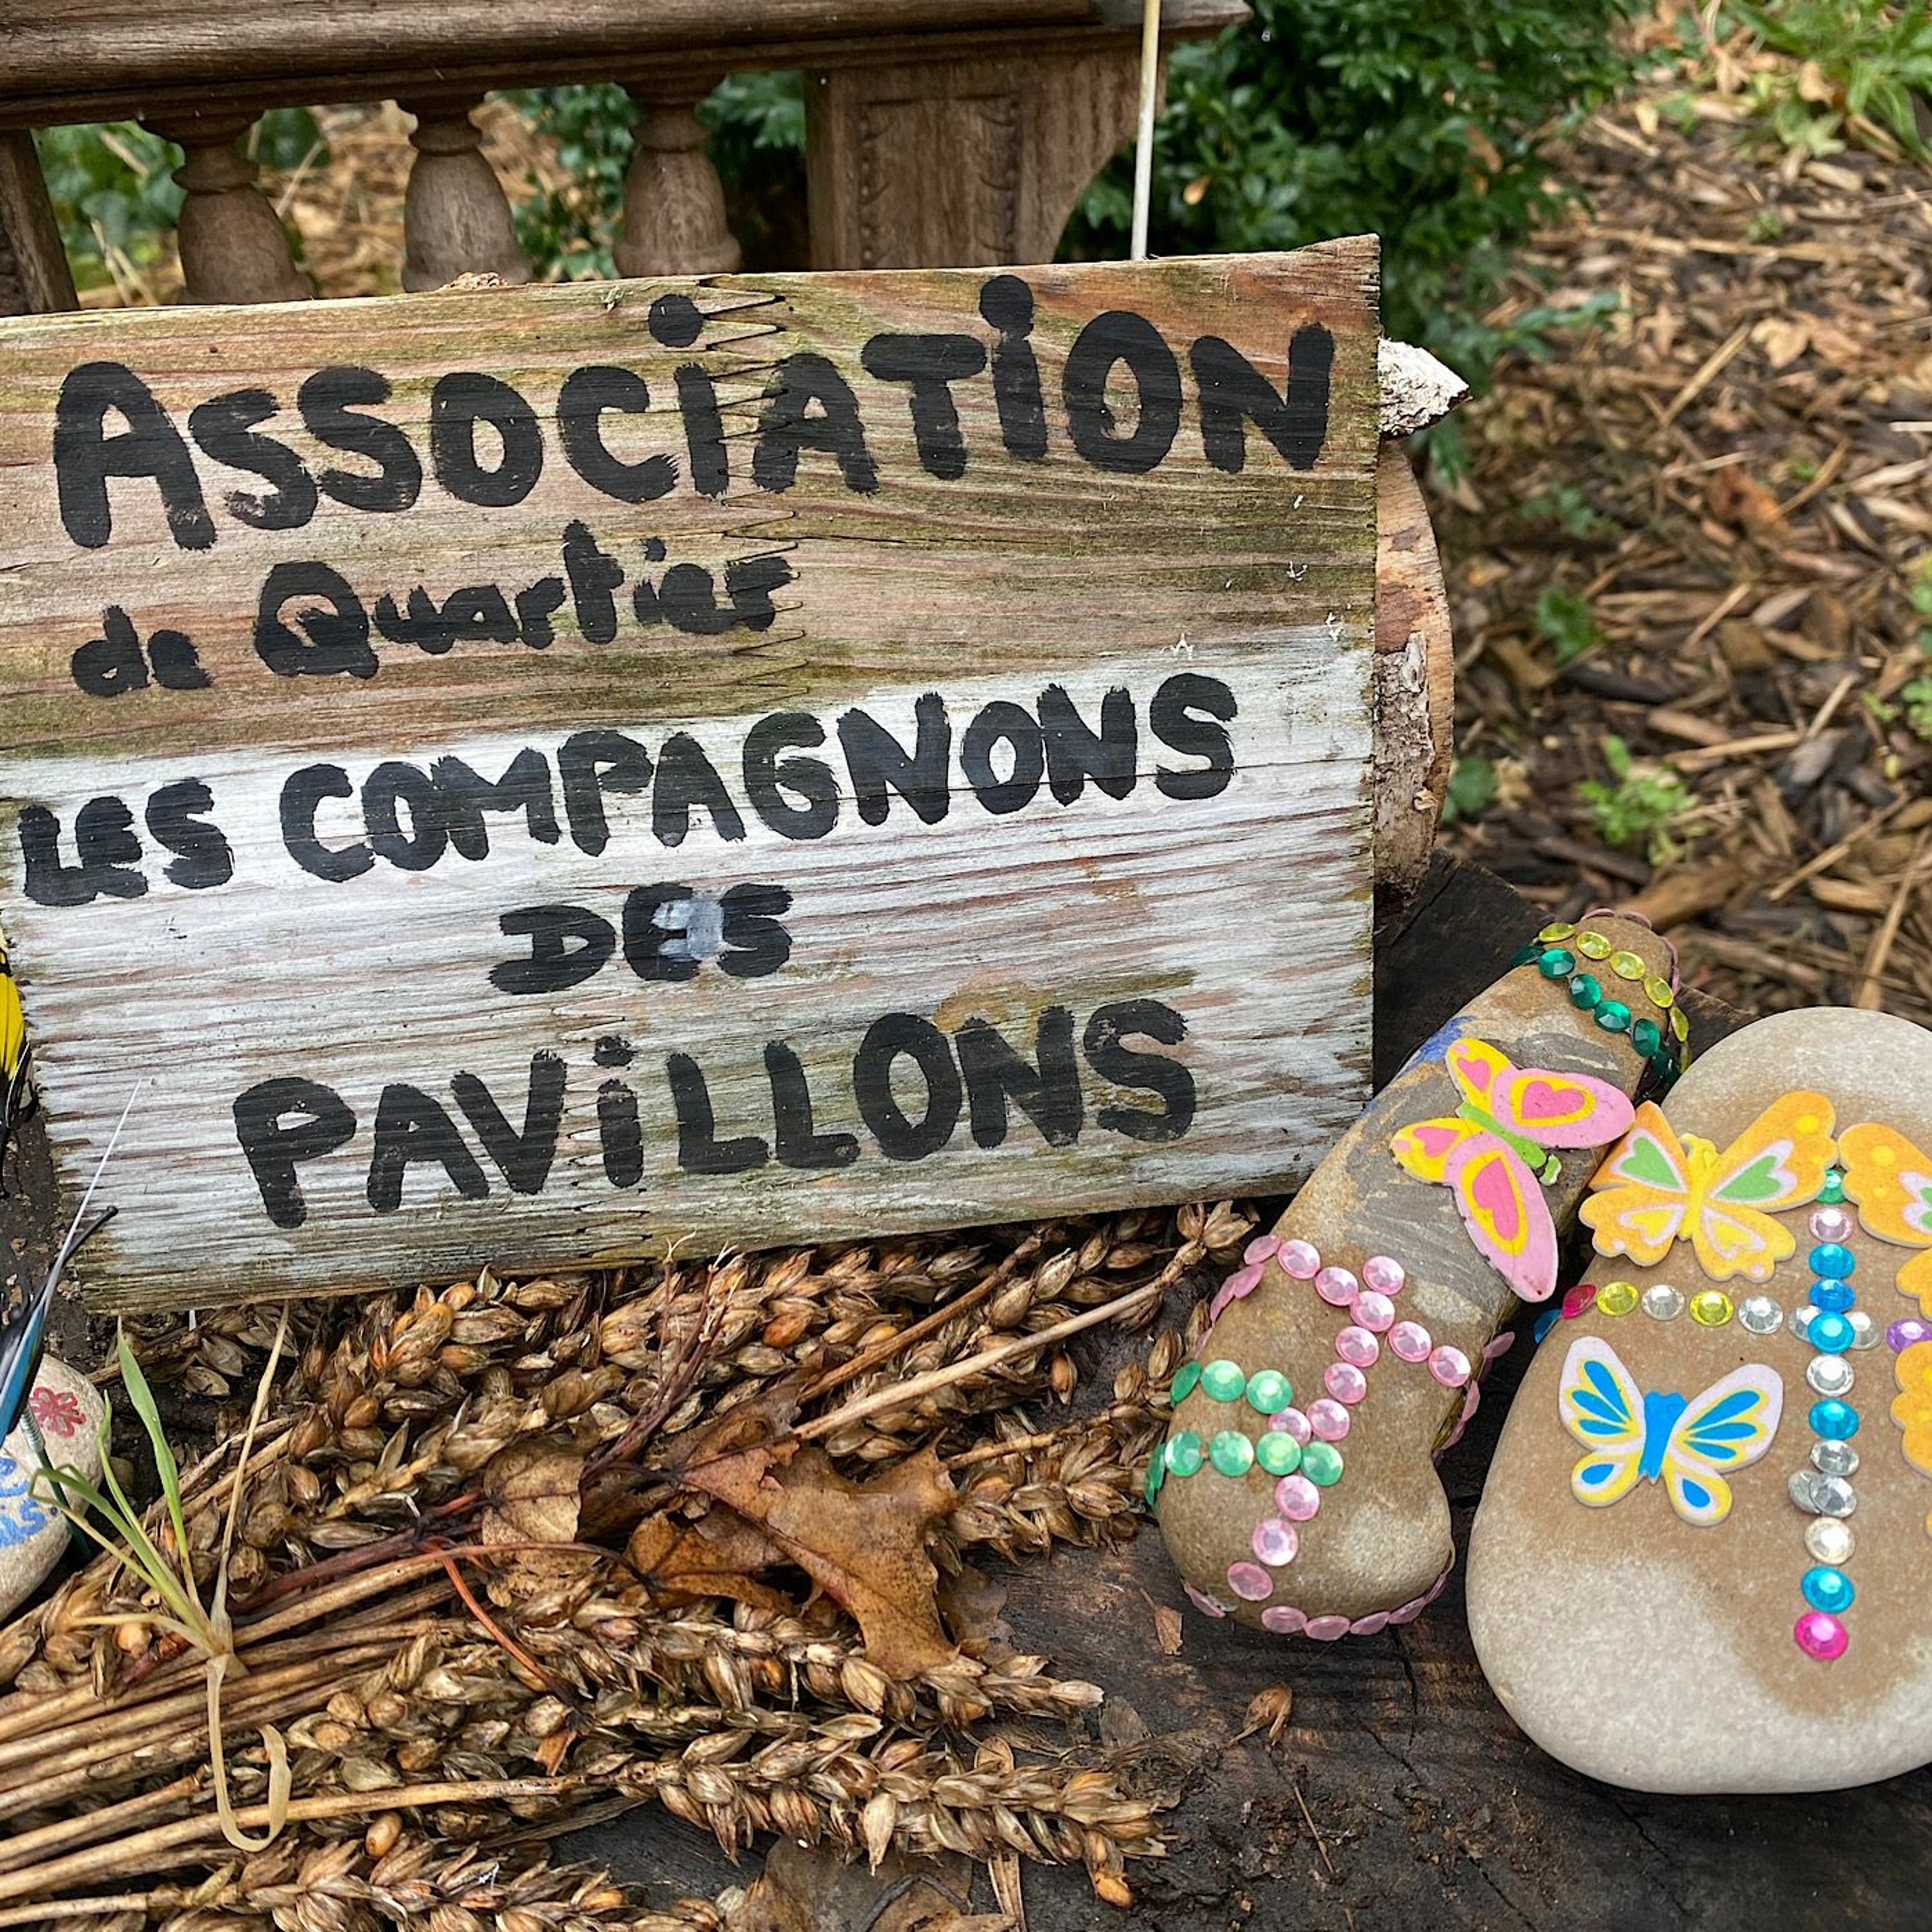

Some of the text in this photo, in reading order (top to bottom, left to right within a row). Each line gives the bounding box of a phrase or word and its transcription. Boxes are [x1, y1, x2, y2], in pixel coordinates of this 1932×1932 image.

[71, 520, 800, 697] de Quartier
[18, 673, 1237, 906] LES COMPAGNONS
[488, 882, 793, 995] DES
